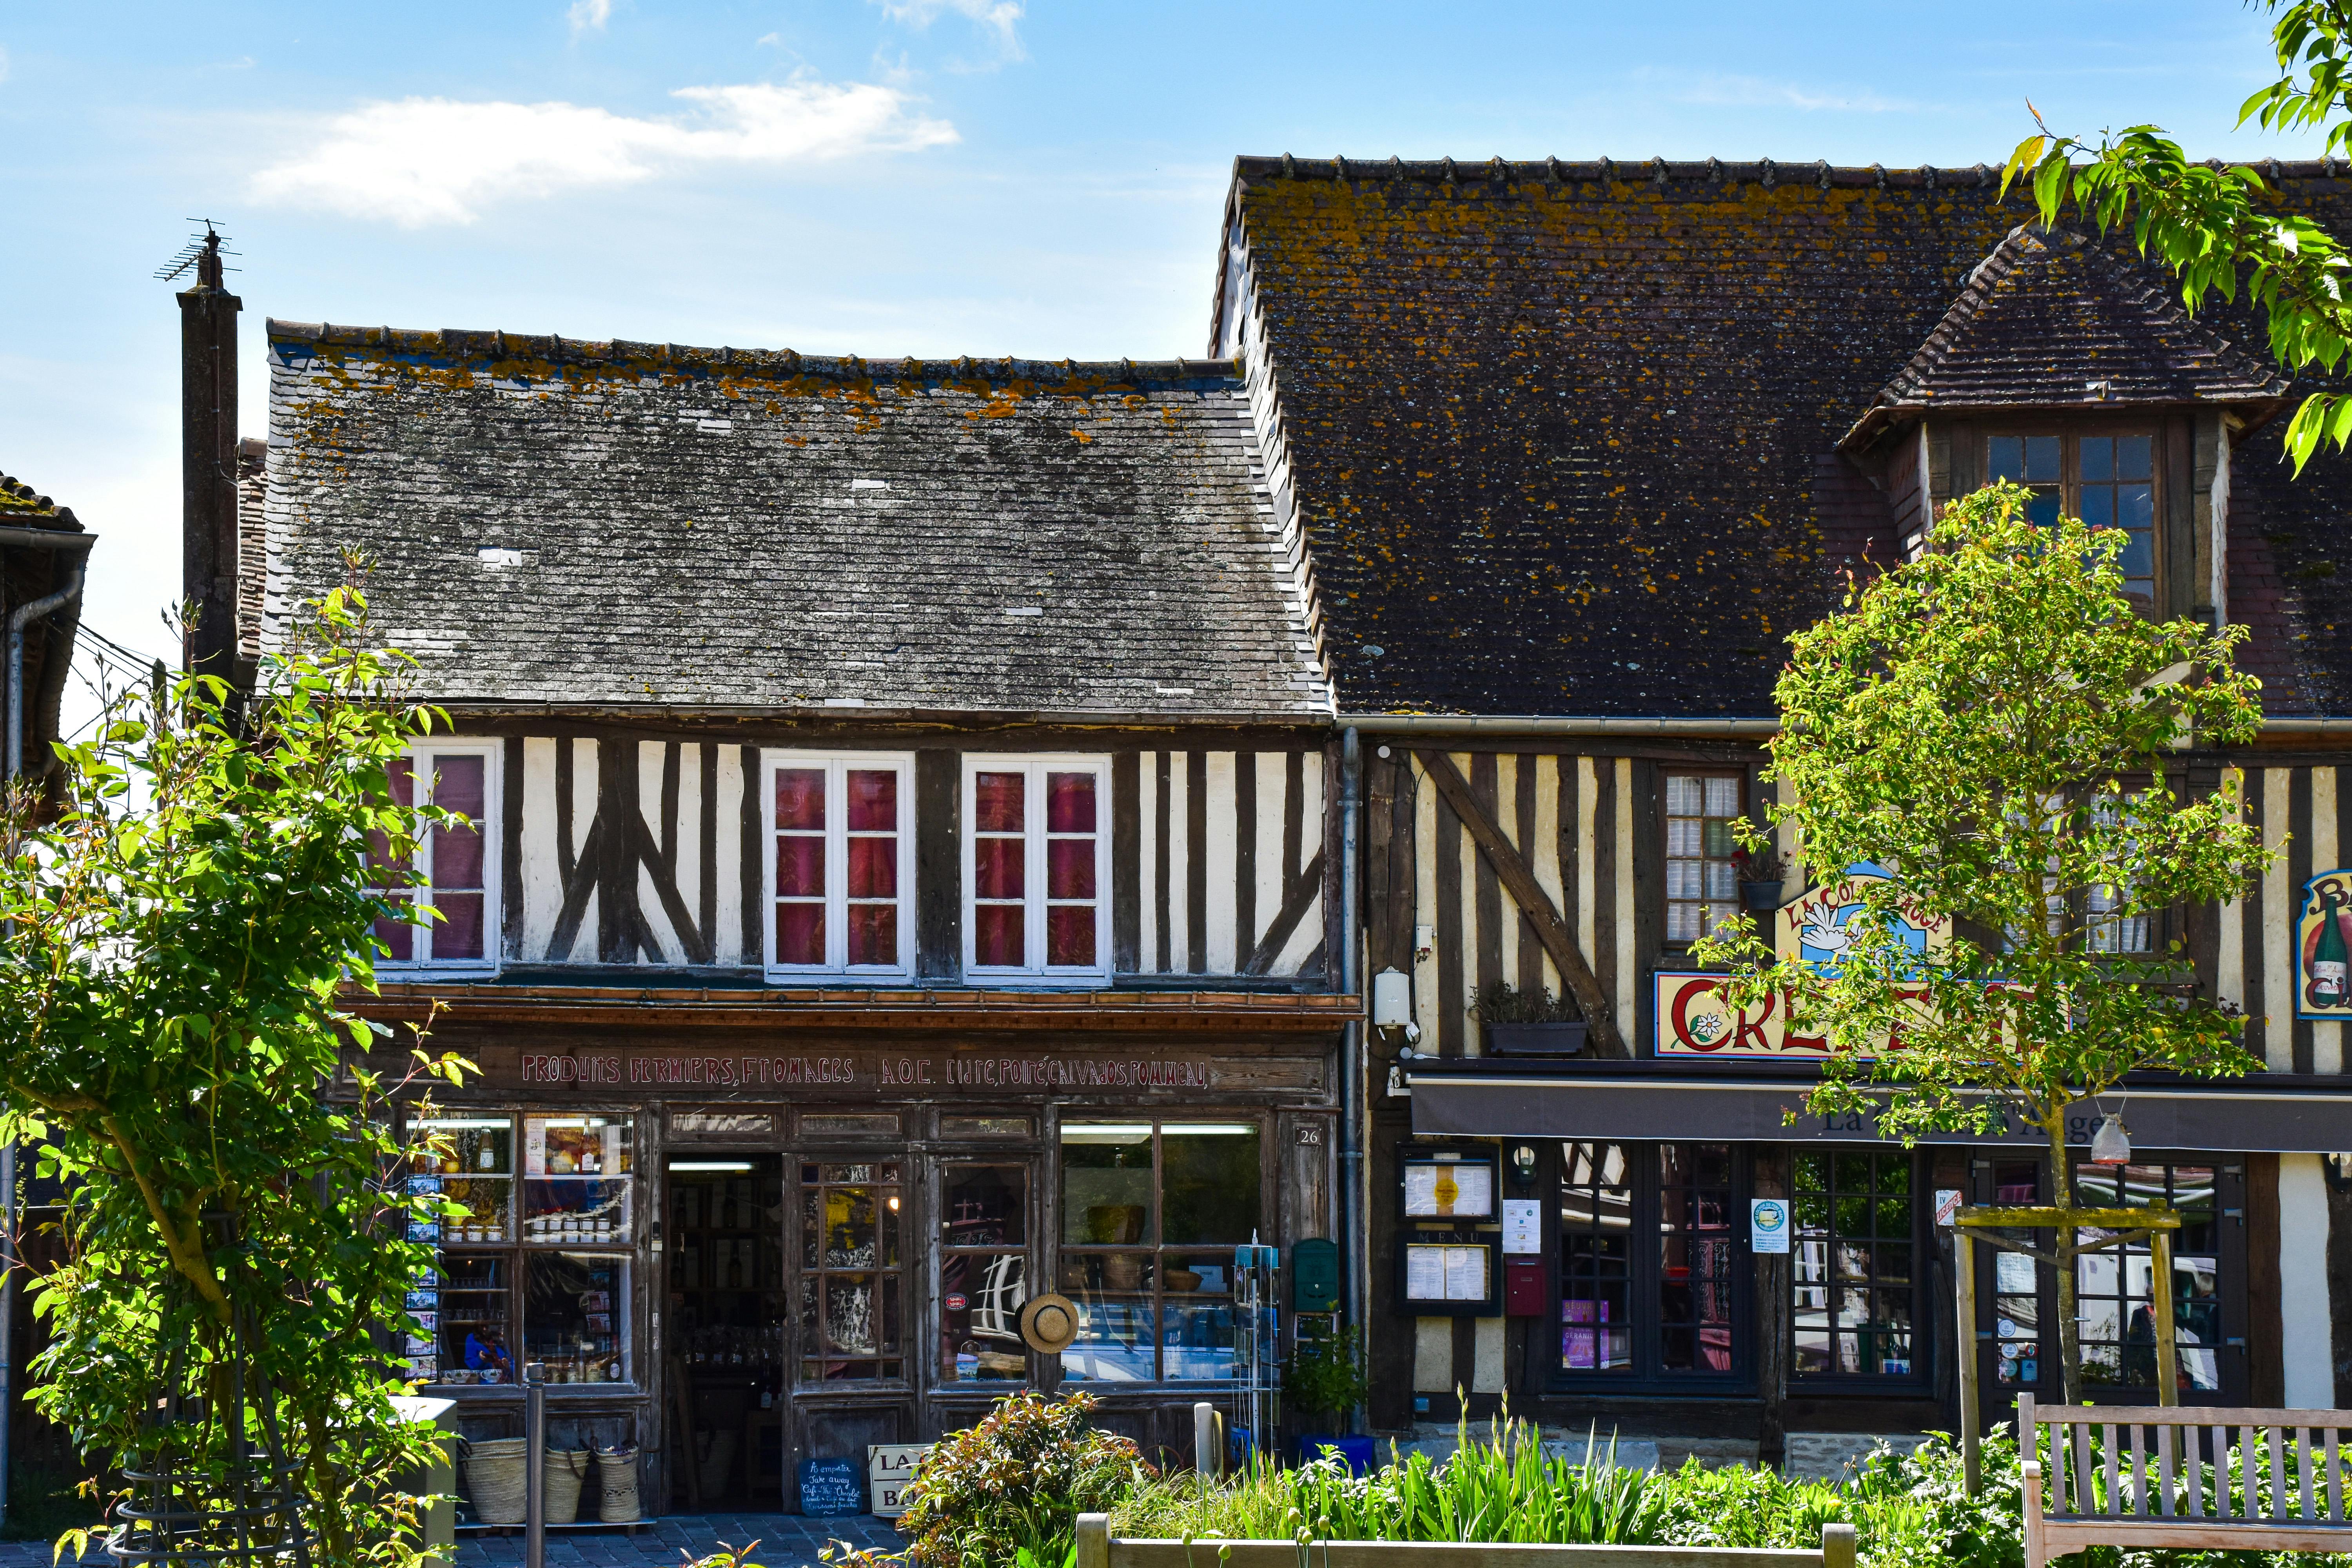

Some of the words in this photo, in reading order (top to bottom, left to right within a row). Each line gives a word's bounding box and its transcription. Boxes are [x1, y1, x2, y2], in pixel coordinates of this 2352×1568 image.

[2305, 977, 2352, 1009] Ci
[1823, 1109, 1862, 1131] La
[1301, 1130, 1318, 1143] 26
[1937, 1192, 1961, 1222] LICENCE
[1419, 1232, 1479, 1243] MENU
[820, 1464, 851, 1474] emporter
[880, 1454, 913, 1470] LA
[809, 1475, 825, 1484] Take
[829, 1477, 851, 1490] away
